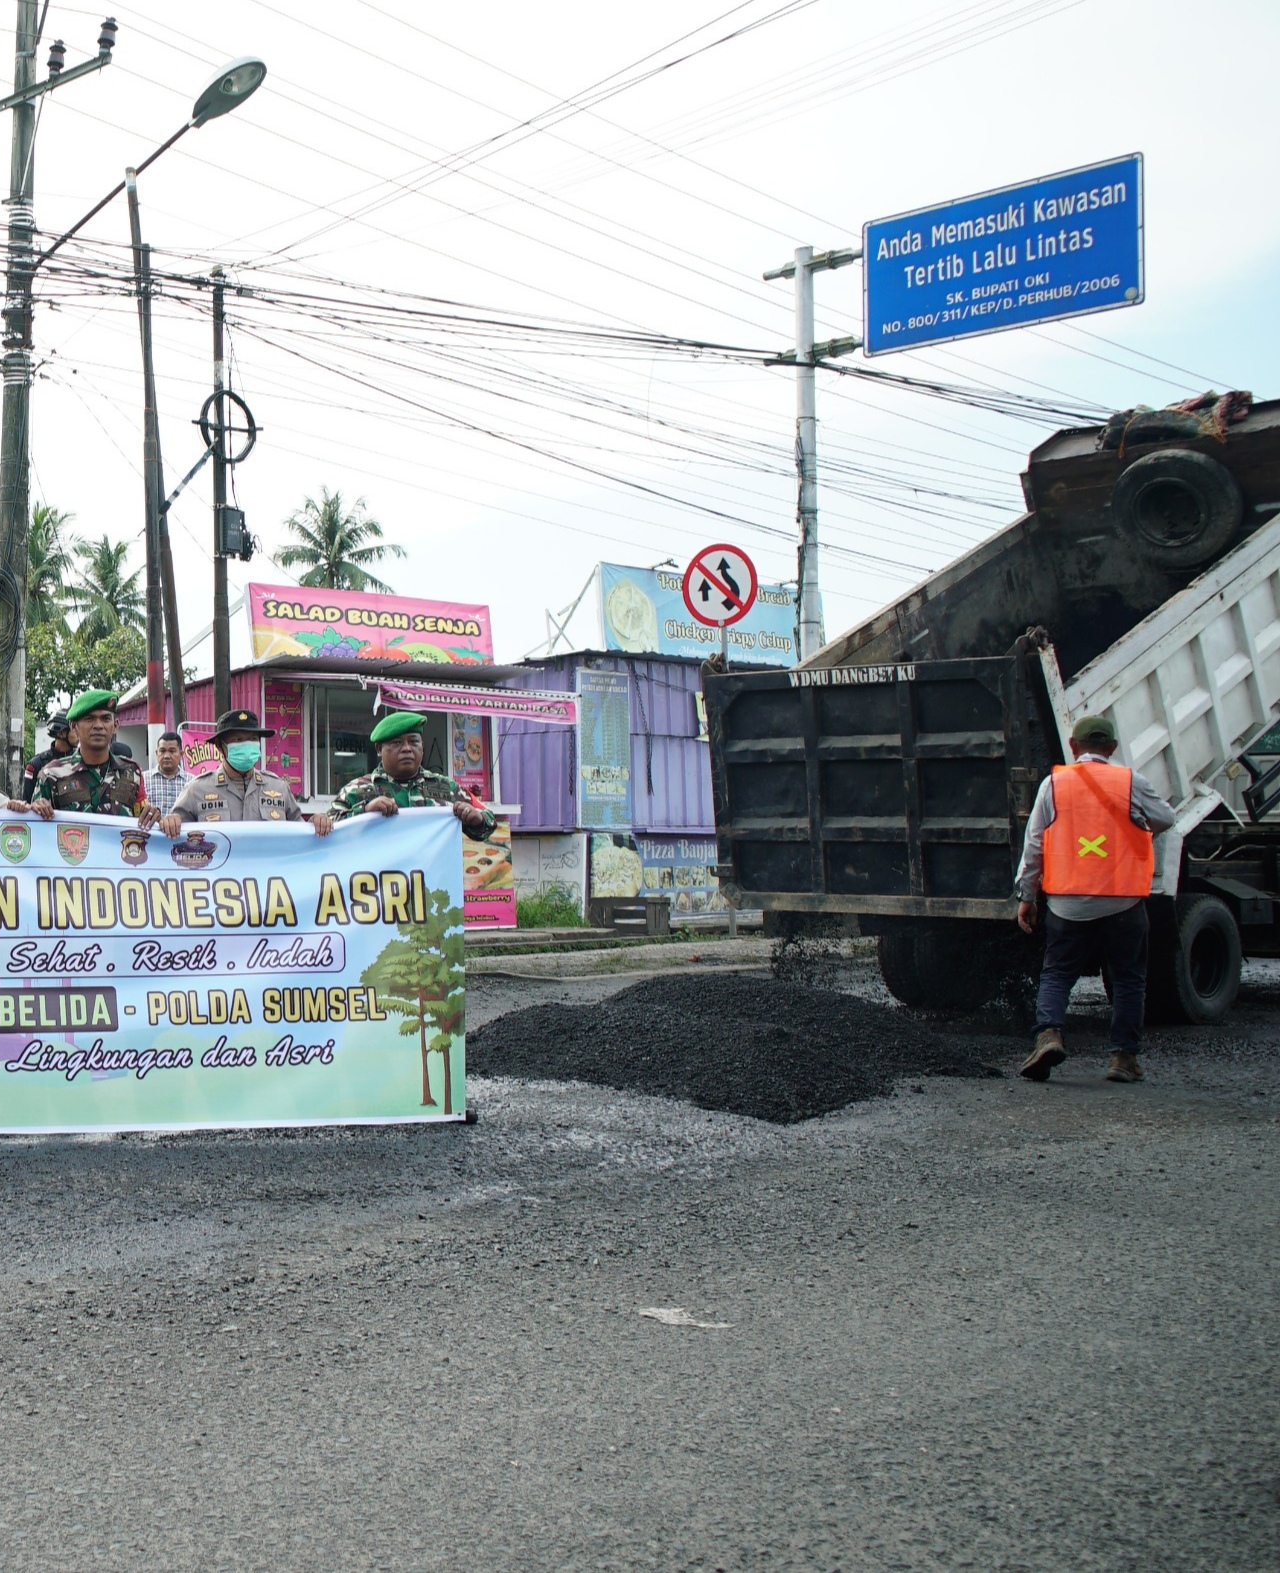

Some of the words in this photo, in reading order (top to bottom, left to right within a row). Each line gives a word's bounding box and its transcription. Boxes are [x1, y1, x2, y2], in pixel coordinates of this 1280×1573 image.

[876, 230, 922, 261] Anda
[931, 203, 1024, 248] Memasuki
[1033, 181, 1126, 224] Kawasan
[904, 253, 964, 288] Tertib
[972, 244, 1016, 274] Lalu
[1025, 226, 1093, 262] Lintas
[946, 292, 969, 306] SK.
[972, 279, 1019, 301] BUPATI
[1024, 272, 1051, 289] OKI
[757, 586, 791, 606] Bread
[263, 599, 343, 623] SALAD
[345, 608, 410, 631] BUAH
[412, 614, 482, 637] SENJA
[664, 619, 715, 643] Chicken
[758, 630, 792, 653] Celup
[896, 664, 916, 682] KU
[381, 689, 425, 702] ALAD
[430, 694, 470, 705] BUAH
[474, 699, 528, 712] VARIAN
[529, 703, 569, 716] RASA
[185, 739, 211, 769] Salad
[201, 801, 224, 810] UDIN
[261, 798, 285, 808] POLRI
[640, 839, 675, 860] Pizza
[36, 873, 298, 931] INDONESIA
[315, 869, 427, 927] ASRI
[6, 939, 102, 974] Sehat
[133, 938, 217, 971] Resik
[246, 935, 334, 970] Indah
[147, 988, 252, 1026] POLDA
[262, 986, 388, 1024] SUMSEL
[5, 1038, 192, 1081] Lingkungan
[201, 1035, 256, 1068] dan
[265, 1034, 335, 1066] Asri
